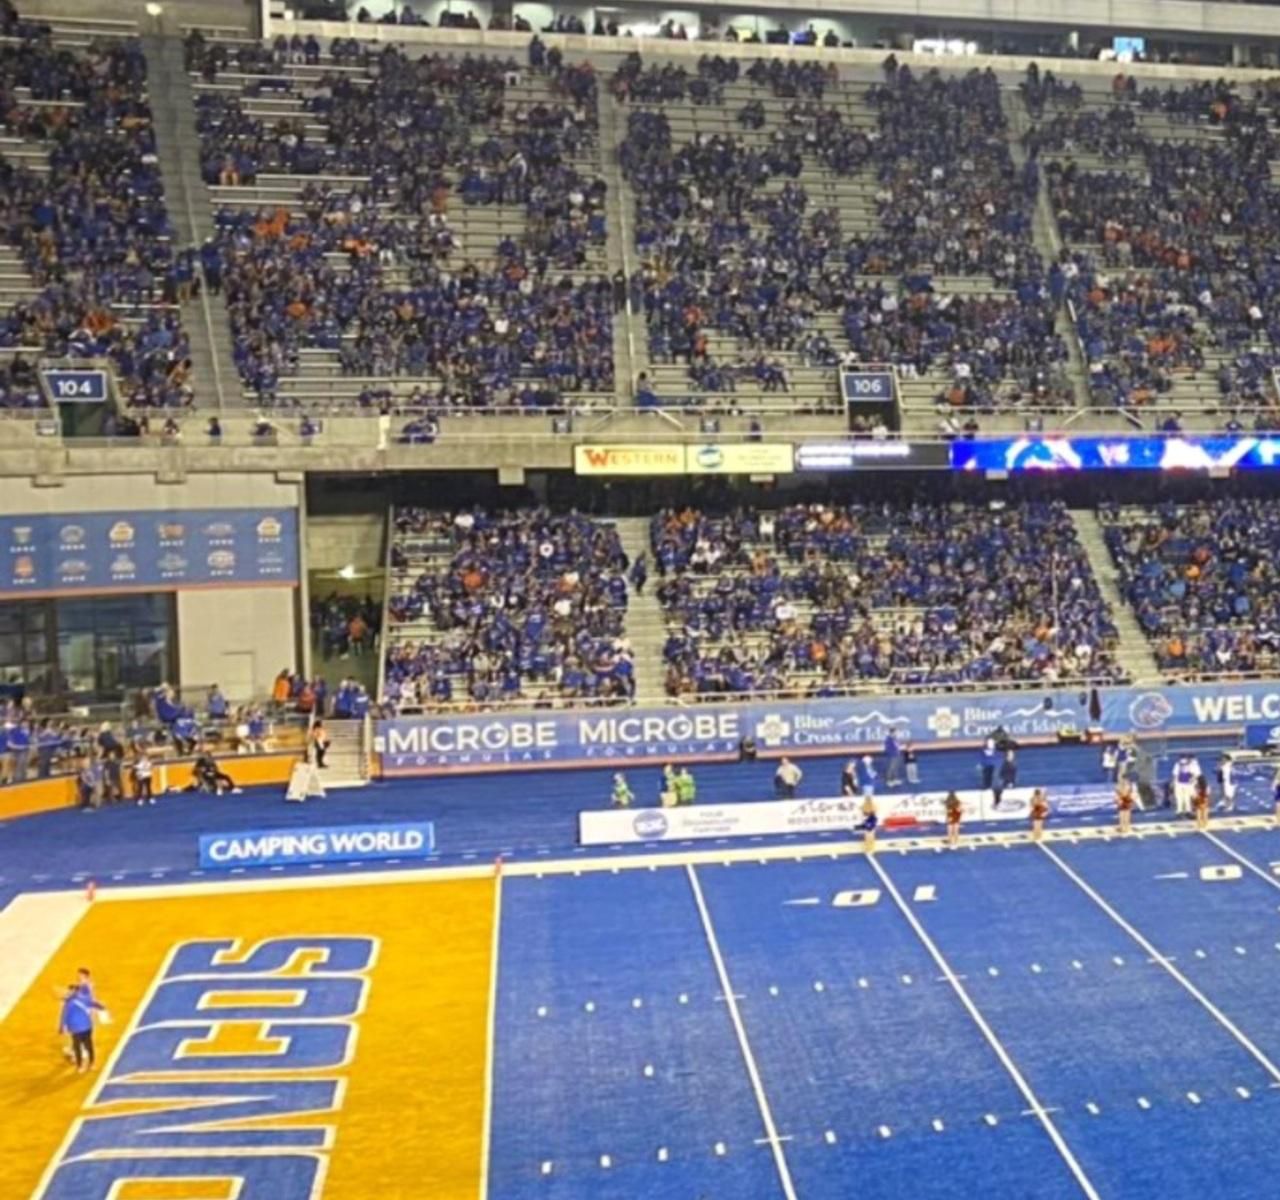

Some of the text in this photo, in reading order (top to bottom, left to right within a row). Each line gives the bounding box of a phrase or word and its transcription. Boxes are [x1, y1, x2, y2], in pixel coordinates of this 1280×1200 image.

[57, 379, 91, 396] 104
[854, 379, 882, 393] 106
[584, 447, 677, 466] WESTERN
[794, 715, 834, 730] Blue
[964, 708, 1002, 721] Blue
[388, 713, 739, 754] MICROBE MICROBE
[1013, 719, 1030, 733] of
[794, 731, 841, 745] Cross
[845, 728, 862, 743] of
[397, 750, 551, 766] FORMULAS
[209, 831, 423, 861] CAMPING WORLD
